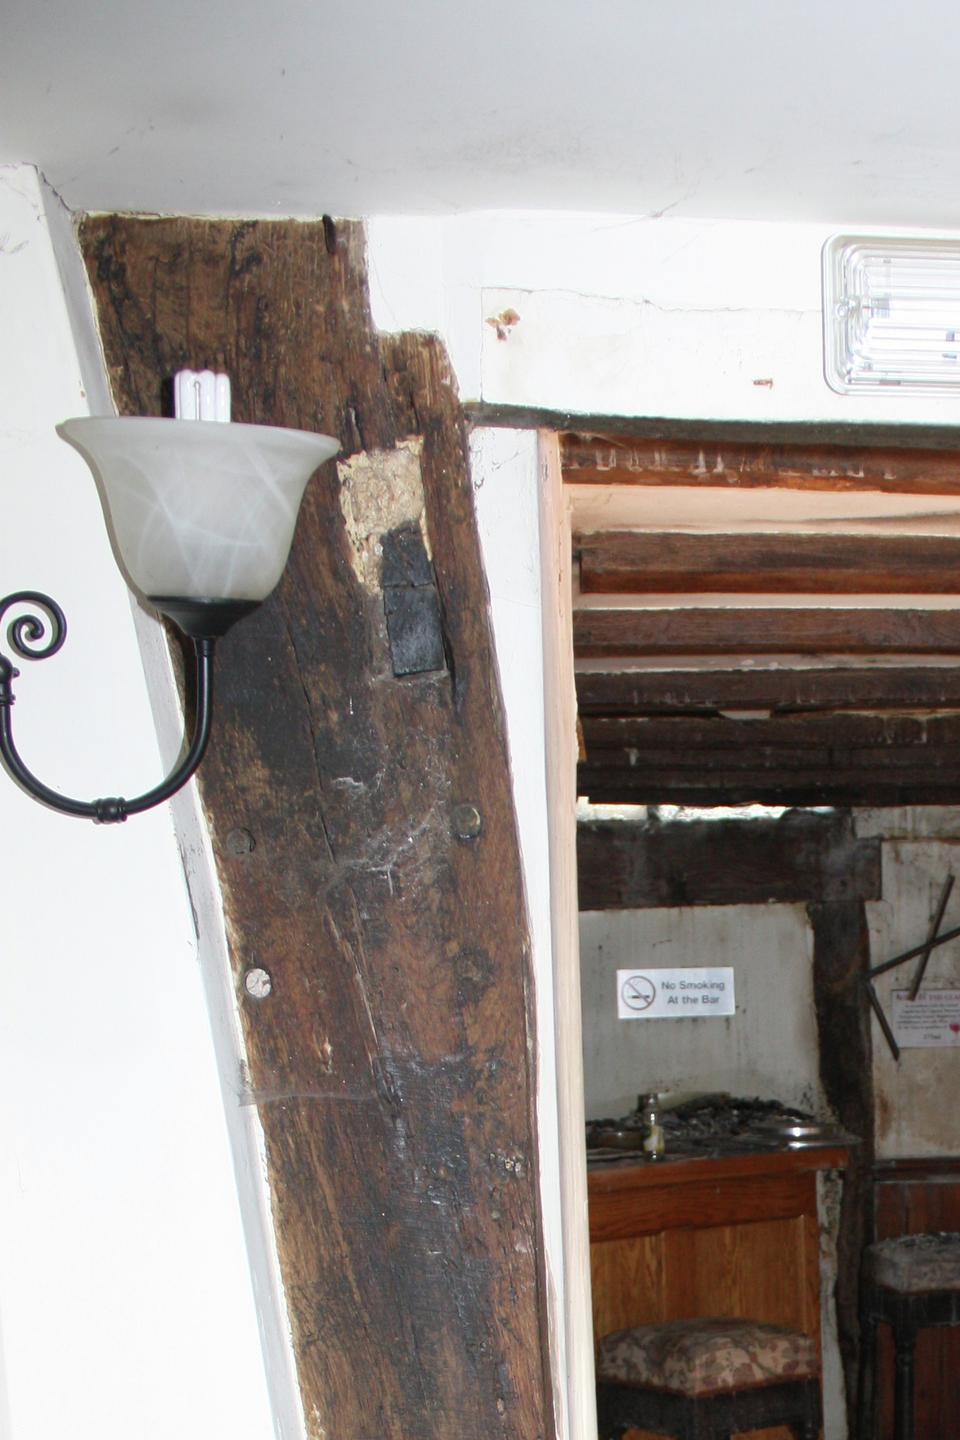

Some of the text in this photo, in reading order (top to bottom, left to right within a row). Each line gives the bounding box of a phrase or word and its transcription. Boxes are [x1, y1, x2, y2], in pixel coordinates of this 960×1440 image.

[661, 980, 725, 992] No Smoking
[667, 995, 720, 1004] At the Bar
